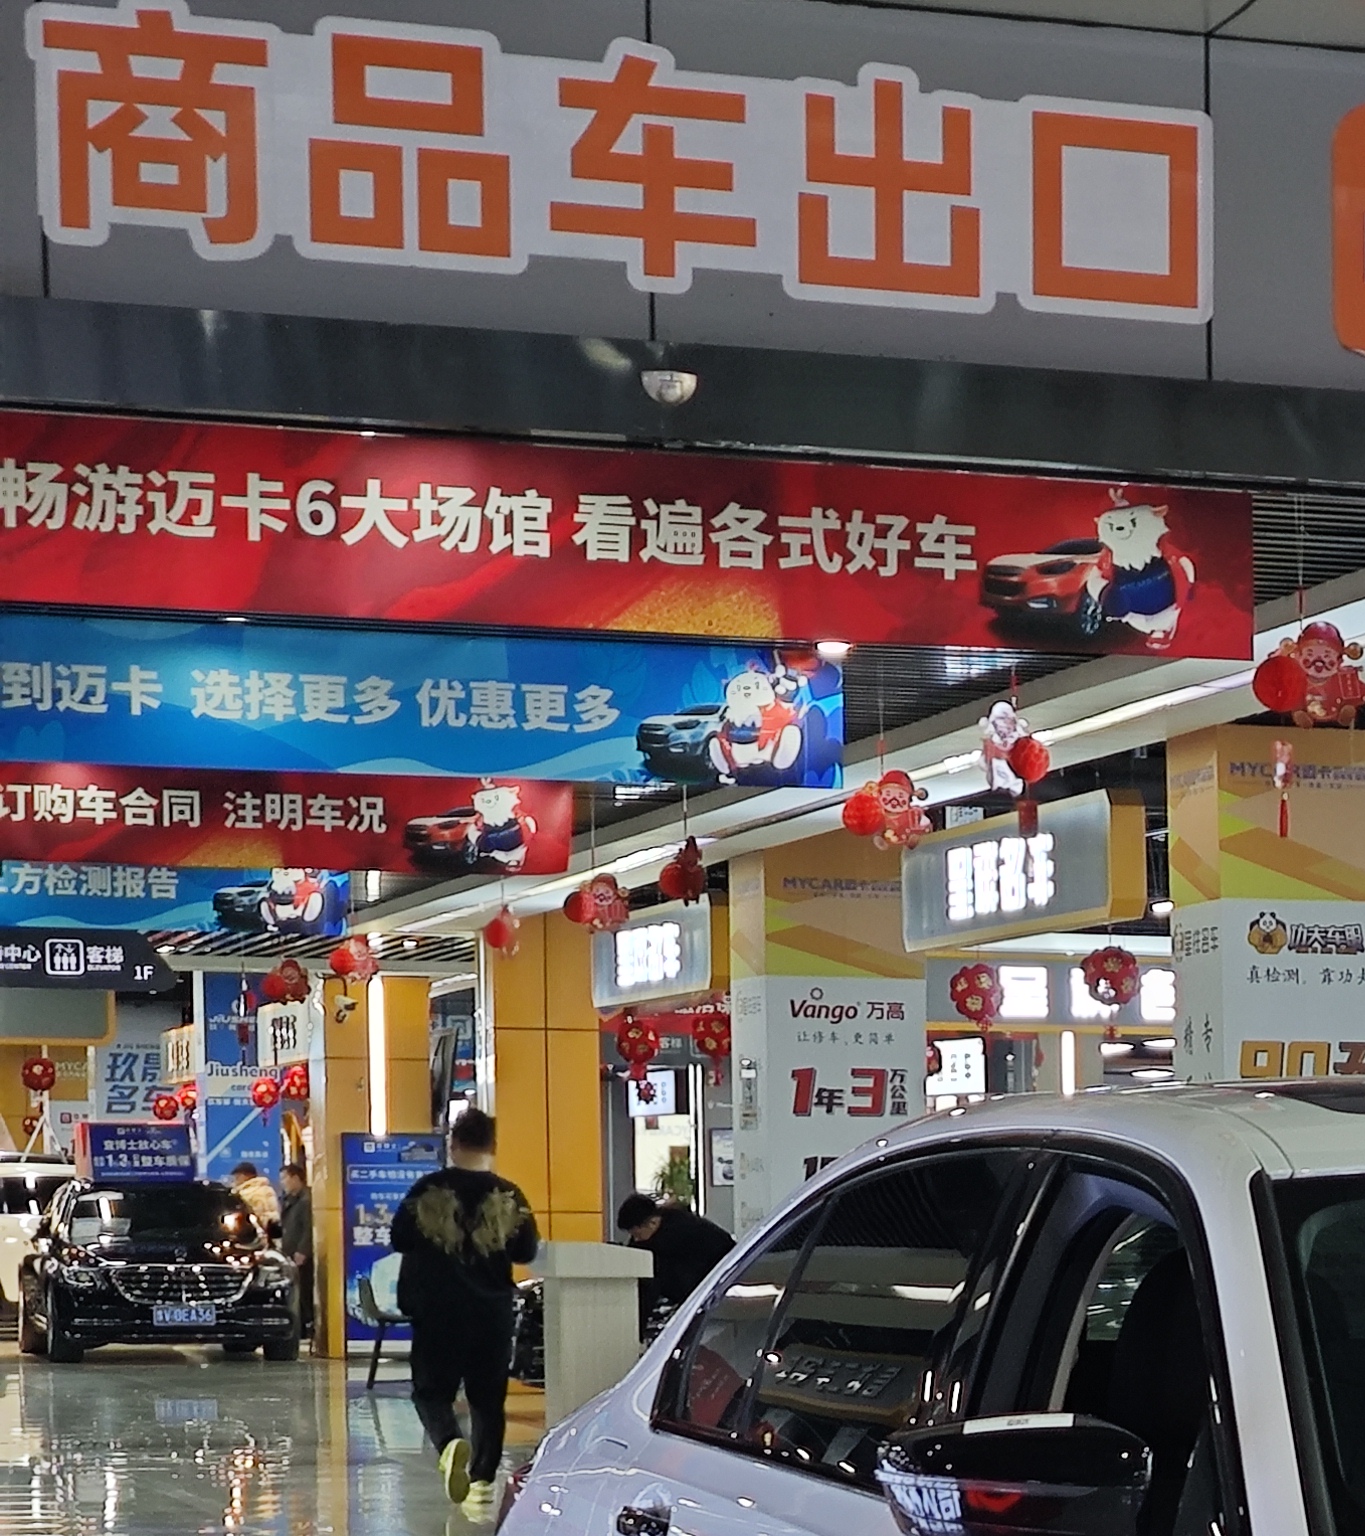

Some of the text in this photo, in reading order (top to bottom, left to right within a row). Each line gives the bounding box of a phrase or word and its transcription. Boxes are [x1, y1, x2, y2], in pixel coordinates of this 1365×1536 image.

[42, 10, 1201, 309] 商品车出口
[0, 458, 978, 581] 畅游迈卡6大场馆 看遍各式好车
[0, 660, 622, 734] 到迈卡 选择更多 优惠更多
[0, 783, 388, 834] 订购车合同 注明车况
[0, 945, 124, 964] 中心 客梯
[134, 966, 154, 981] 1F
[789, 1000, 858, 1025] Vango
[866, 1001, 905, 1021] 万高
